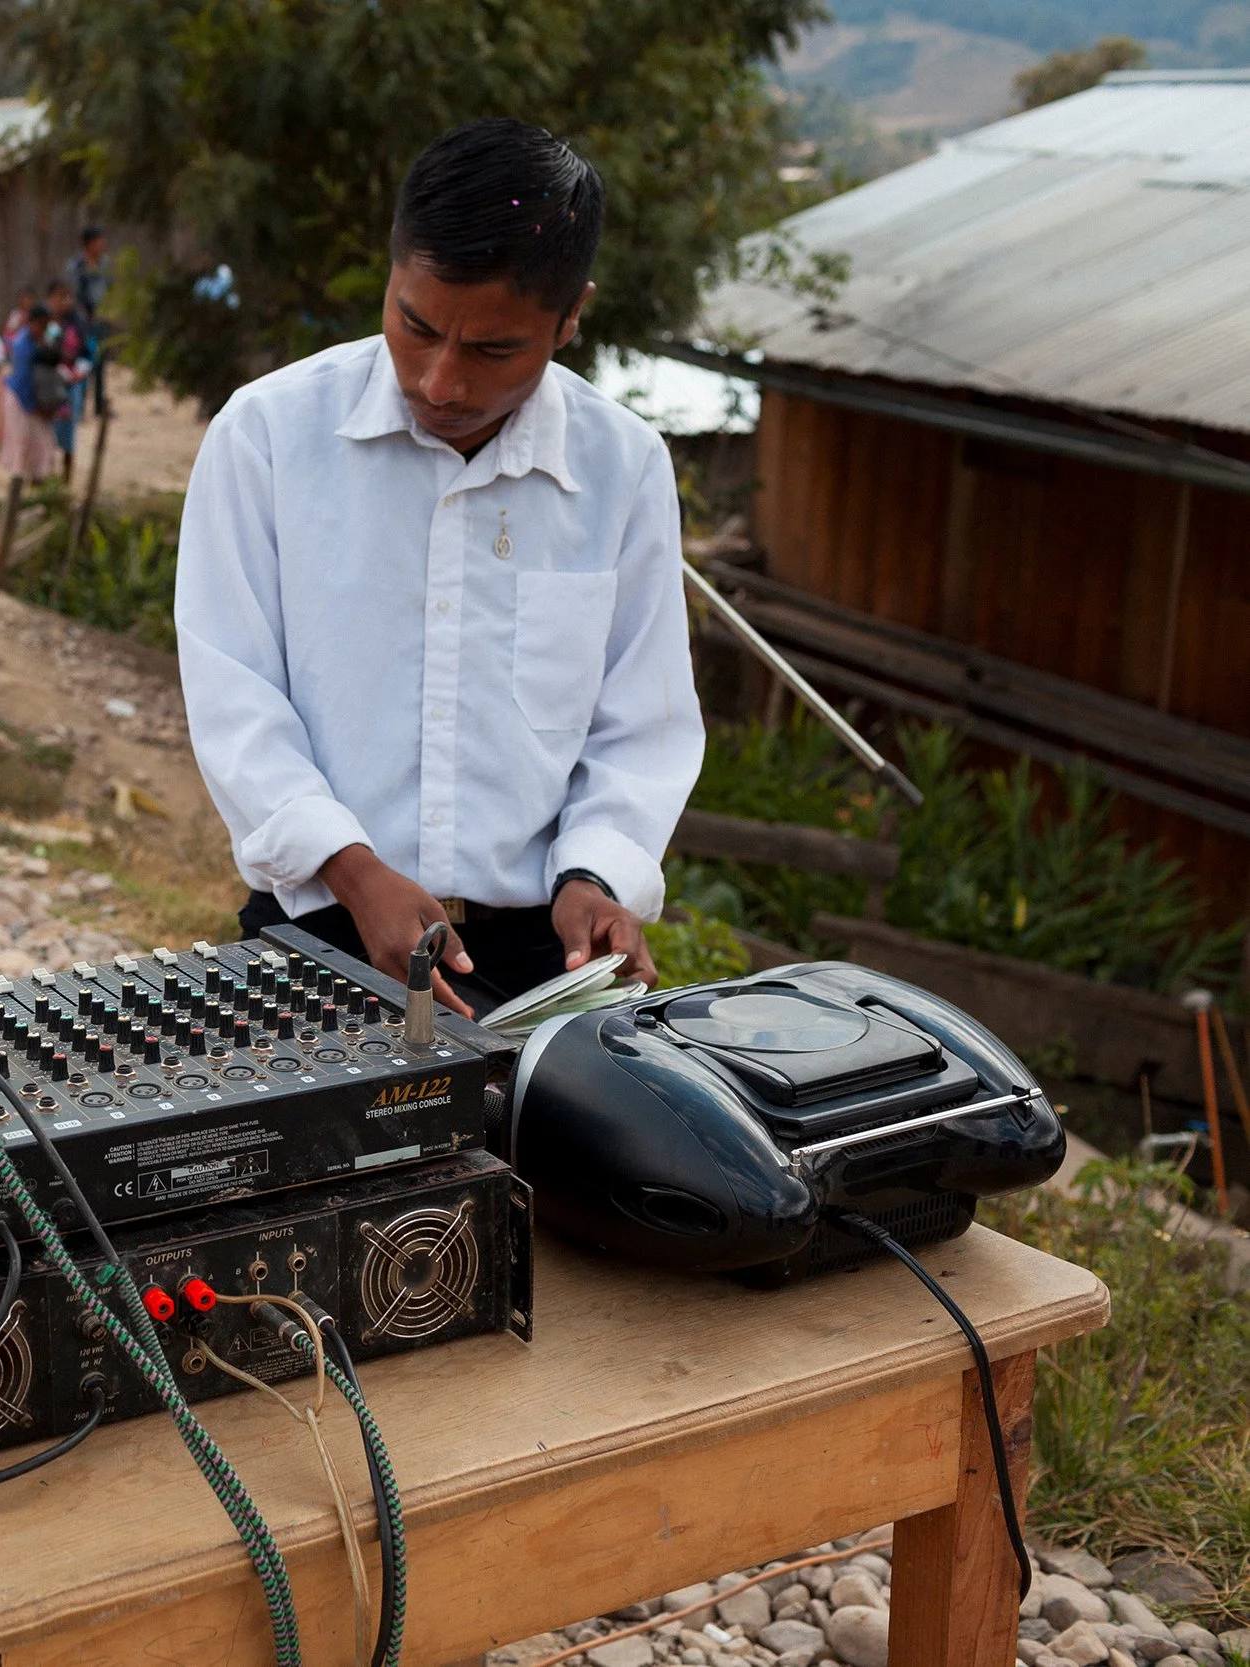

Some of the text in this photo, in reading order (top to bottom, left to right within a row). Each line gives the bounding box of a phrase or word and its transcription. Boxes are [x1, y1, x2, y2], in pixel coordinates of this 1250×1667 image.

[371, 1076, 452, 1108] AM-122
[365, 1095, 452, 1119] STEREO MIXING CONSOLE
[109, 1144, 132, 1153] CAUTION
[104, 1150, 132, 1160] ATTENTION
[108, 1155, 132, 1165] WARNING
[188, 1163, 219, 1174] CAUTION
[194, 1171, 215, 1180] ELECTRIC
[215, 1168, 231, 1176] SHOCK
[114, 1181, 133, 1197] CE
[258, 1226, 294, 1242] INPUTS
[145, 1248, 192, 1266] OUTPUTS
[235, 1267, 241, 1275] B
[207, 1273, 214, 1281] A
[97, 1286, 113, 1295] AMP
